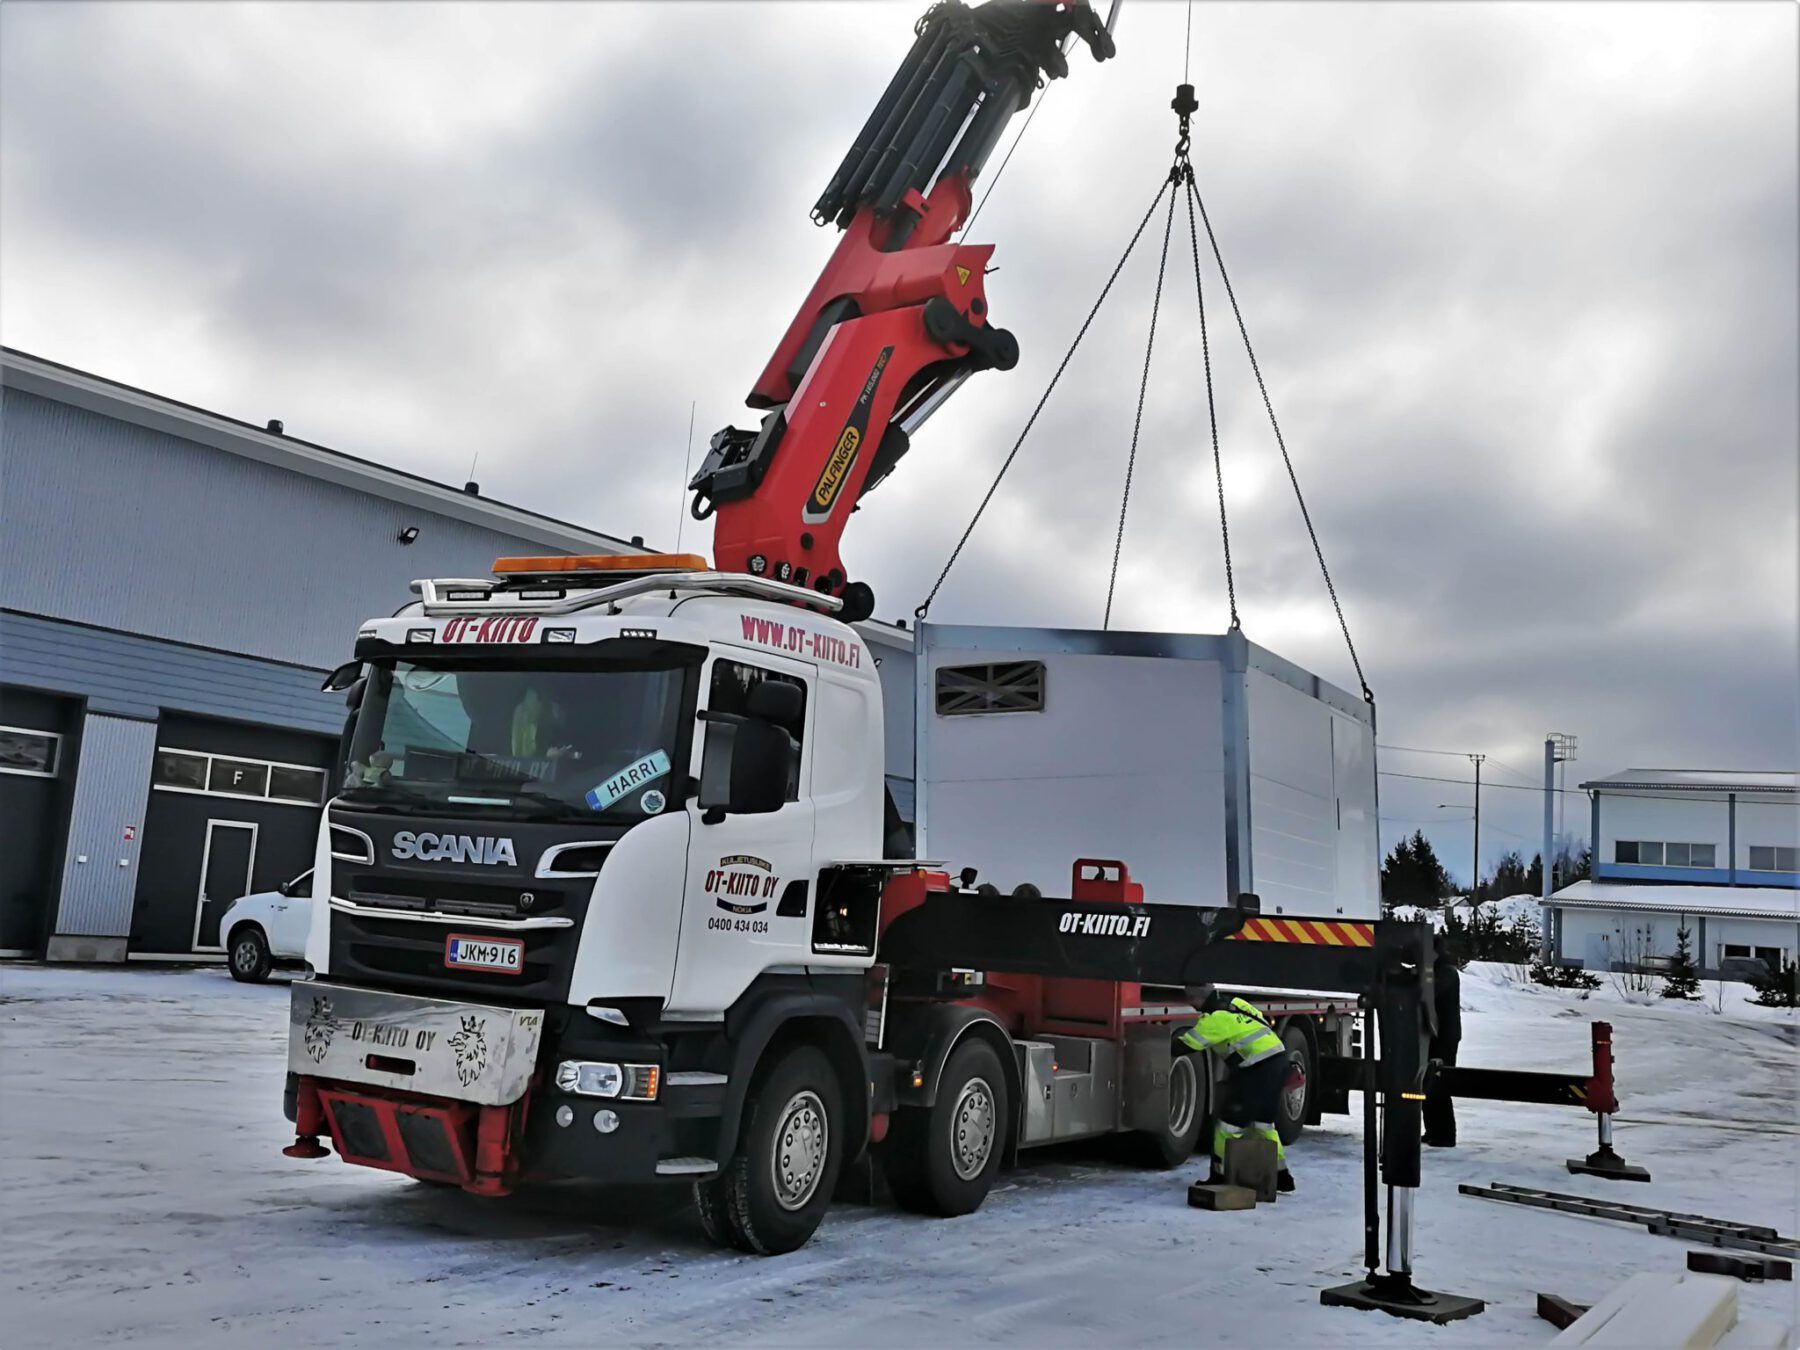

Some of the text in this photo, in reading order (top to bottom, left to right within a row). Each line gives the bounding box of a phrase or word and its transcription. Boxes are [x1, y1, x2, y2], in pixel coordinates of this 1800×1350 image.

[818, 431, 857, 501] PALFINGER
[442, 616, 539, 643] OT-KIITO
[740, 614, 860, 669] WWW.OT-KIITO.FI
[233, 771, 243, 785] F
[606, 759, 658, 798] HARRI
[391, 830, 518, 866] SCANIA
[704, 869, 780, 898] OT-KIITO OY
[732, 905, 752, 913] NOKIA
[708, 917, 768, 933] 0400 434 034
[1059, 912, 1151, 937] OT-KIITO.FI
[460, 943, 517, 965] JKM-916
[352, 1020, 436, 1052] OT-KIITO OY
